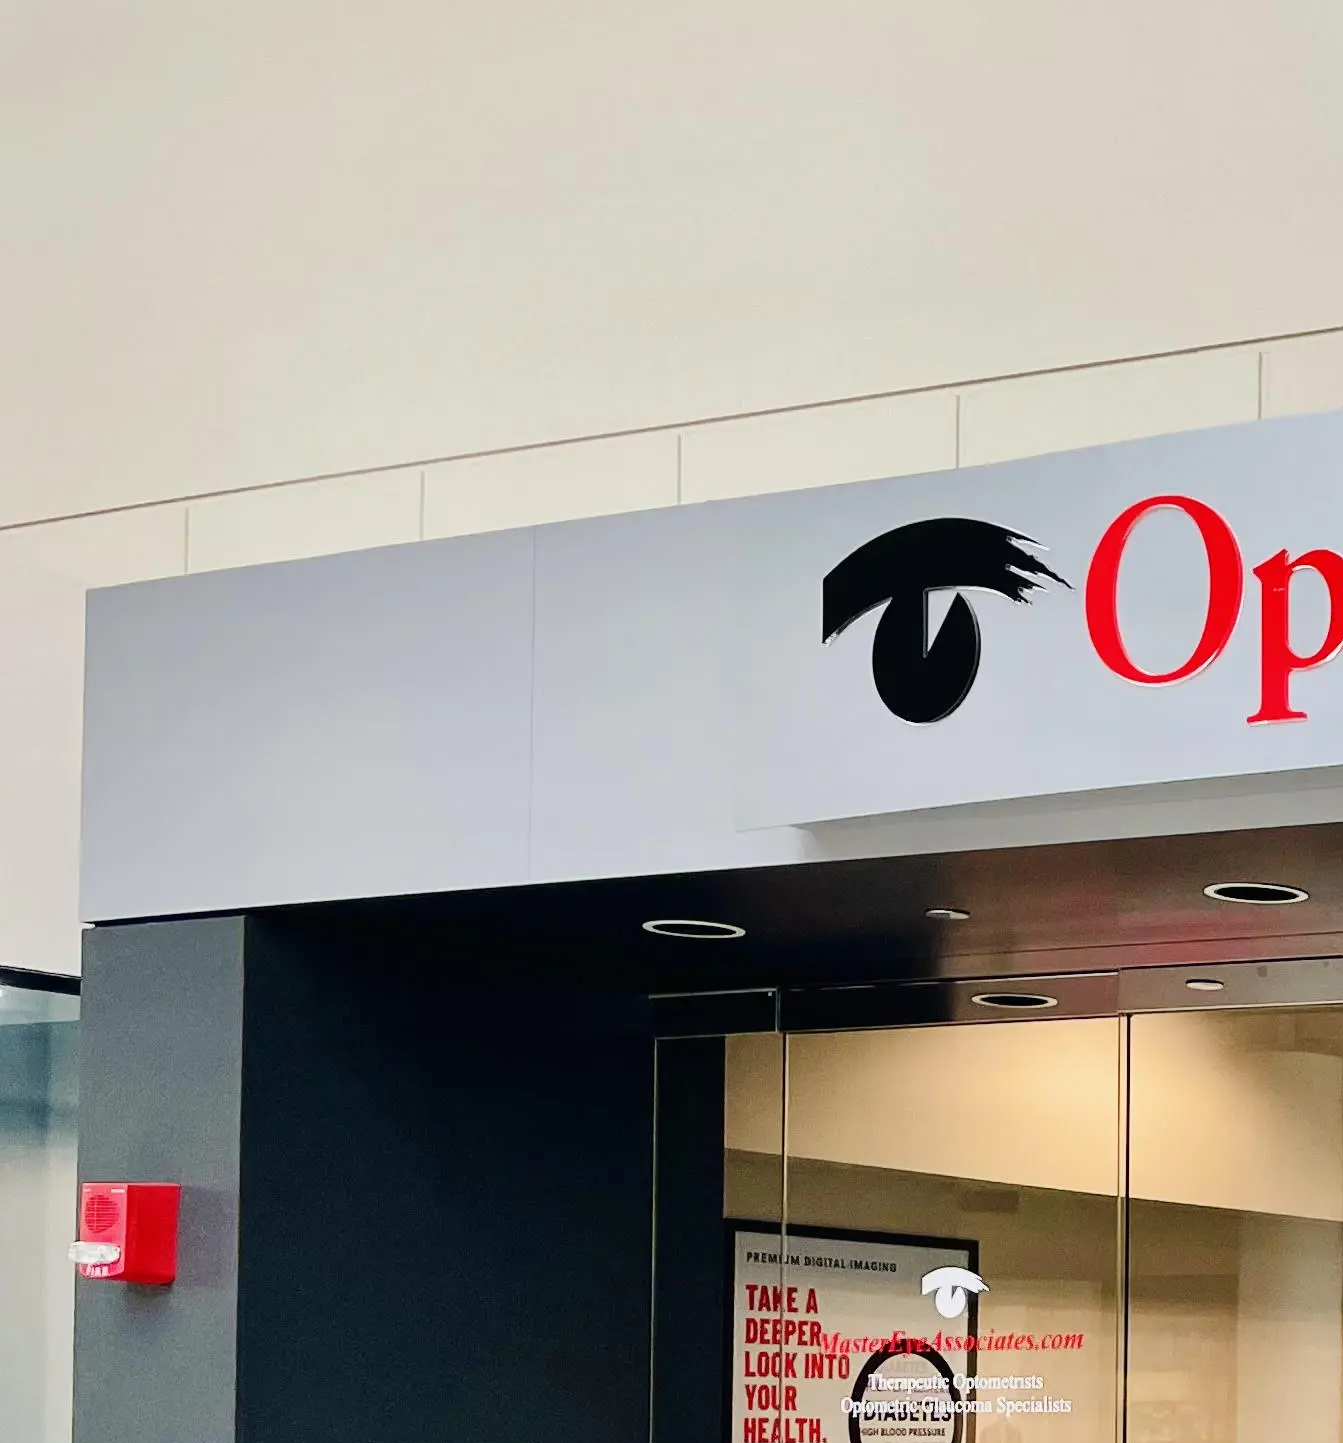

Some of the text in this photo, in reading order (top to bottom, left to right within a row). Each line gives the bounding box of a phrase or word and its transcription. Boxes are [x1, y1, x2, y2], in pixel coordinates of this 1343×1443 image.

[804, 1256, 846, 1269] DIGITAL
[850, 1261, 897, 1273] IMAGING
[745, 1284, 818, 1314] TAKE A
[745, 1317, 822, 1346] DEEPER
[820, 1328, 1084, 1358] MasterEyeAssociates.com
[744, 1351, 850, 1380] LOOK INTO
[868, 1373, 1044, 1394] Therapeutic Optometrists
[744, 1384, 797, 1411] YOUR
[840, 1396, 1072, 1418] Optometric Glaucoma Specialists
[743, 1417, 828, 1443] HEALTH.
